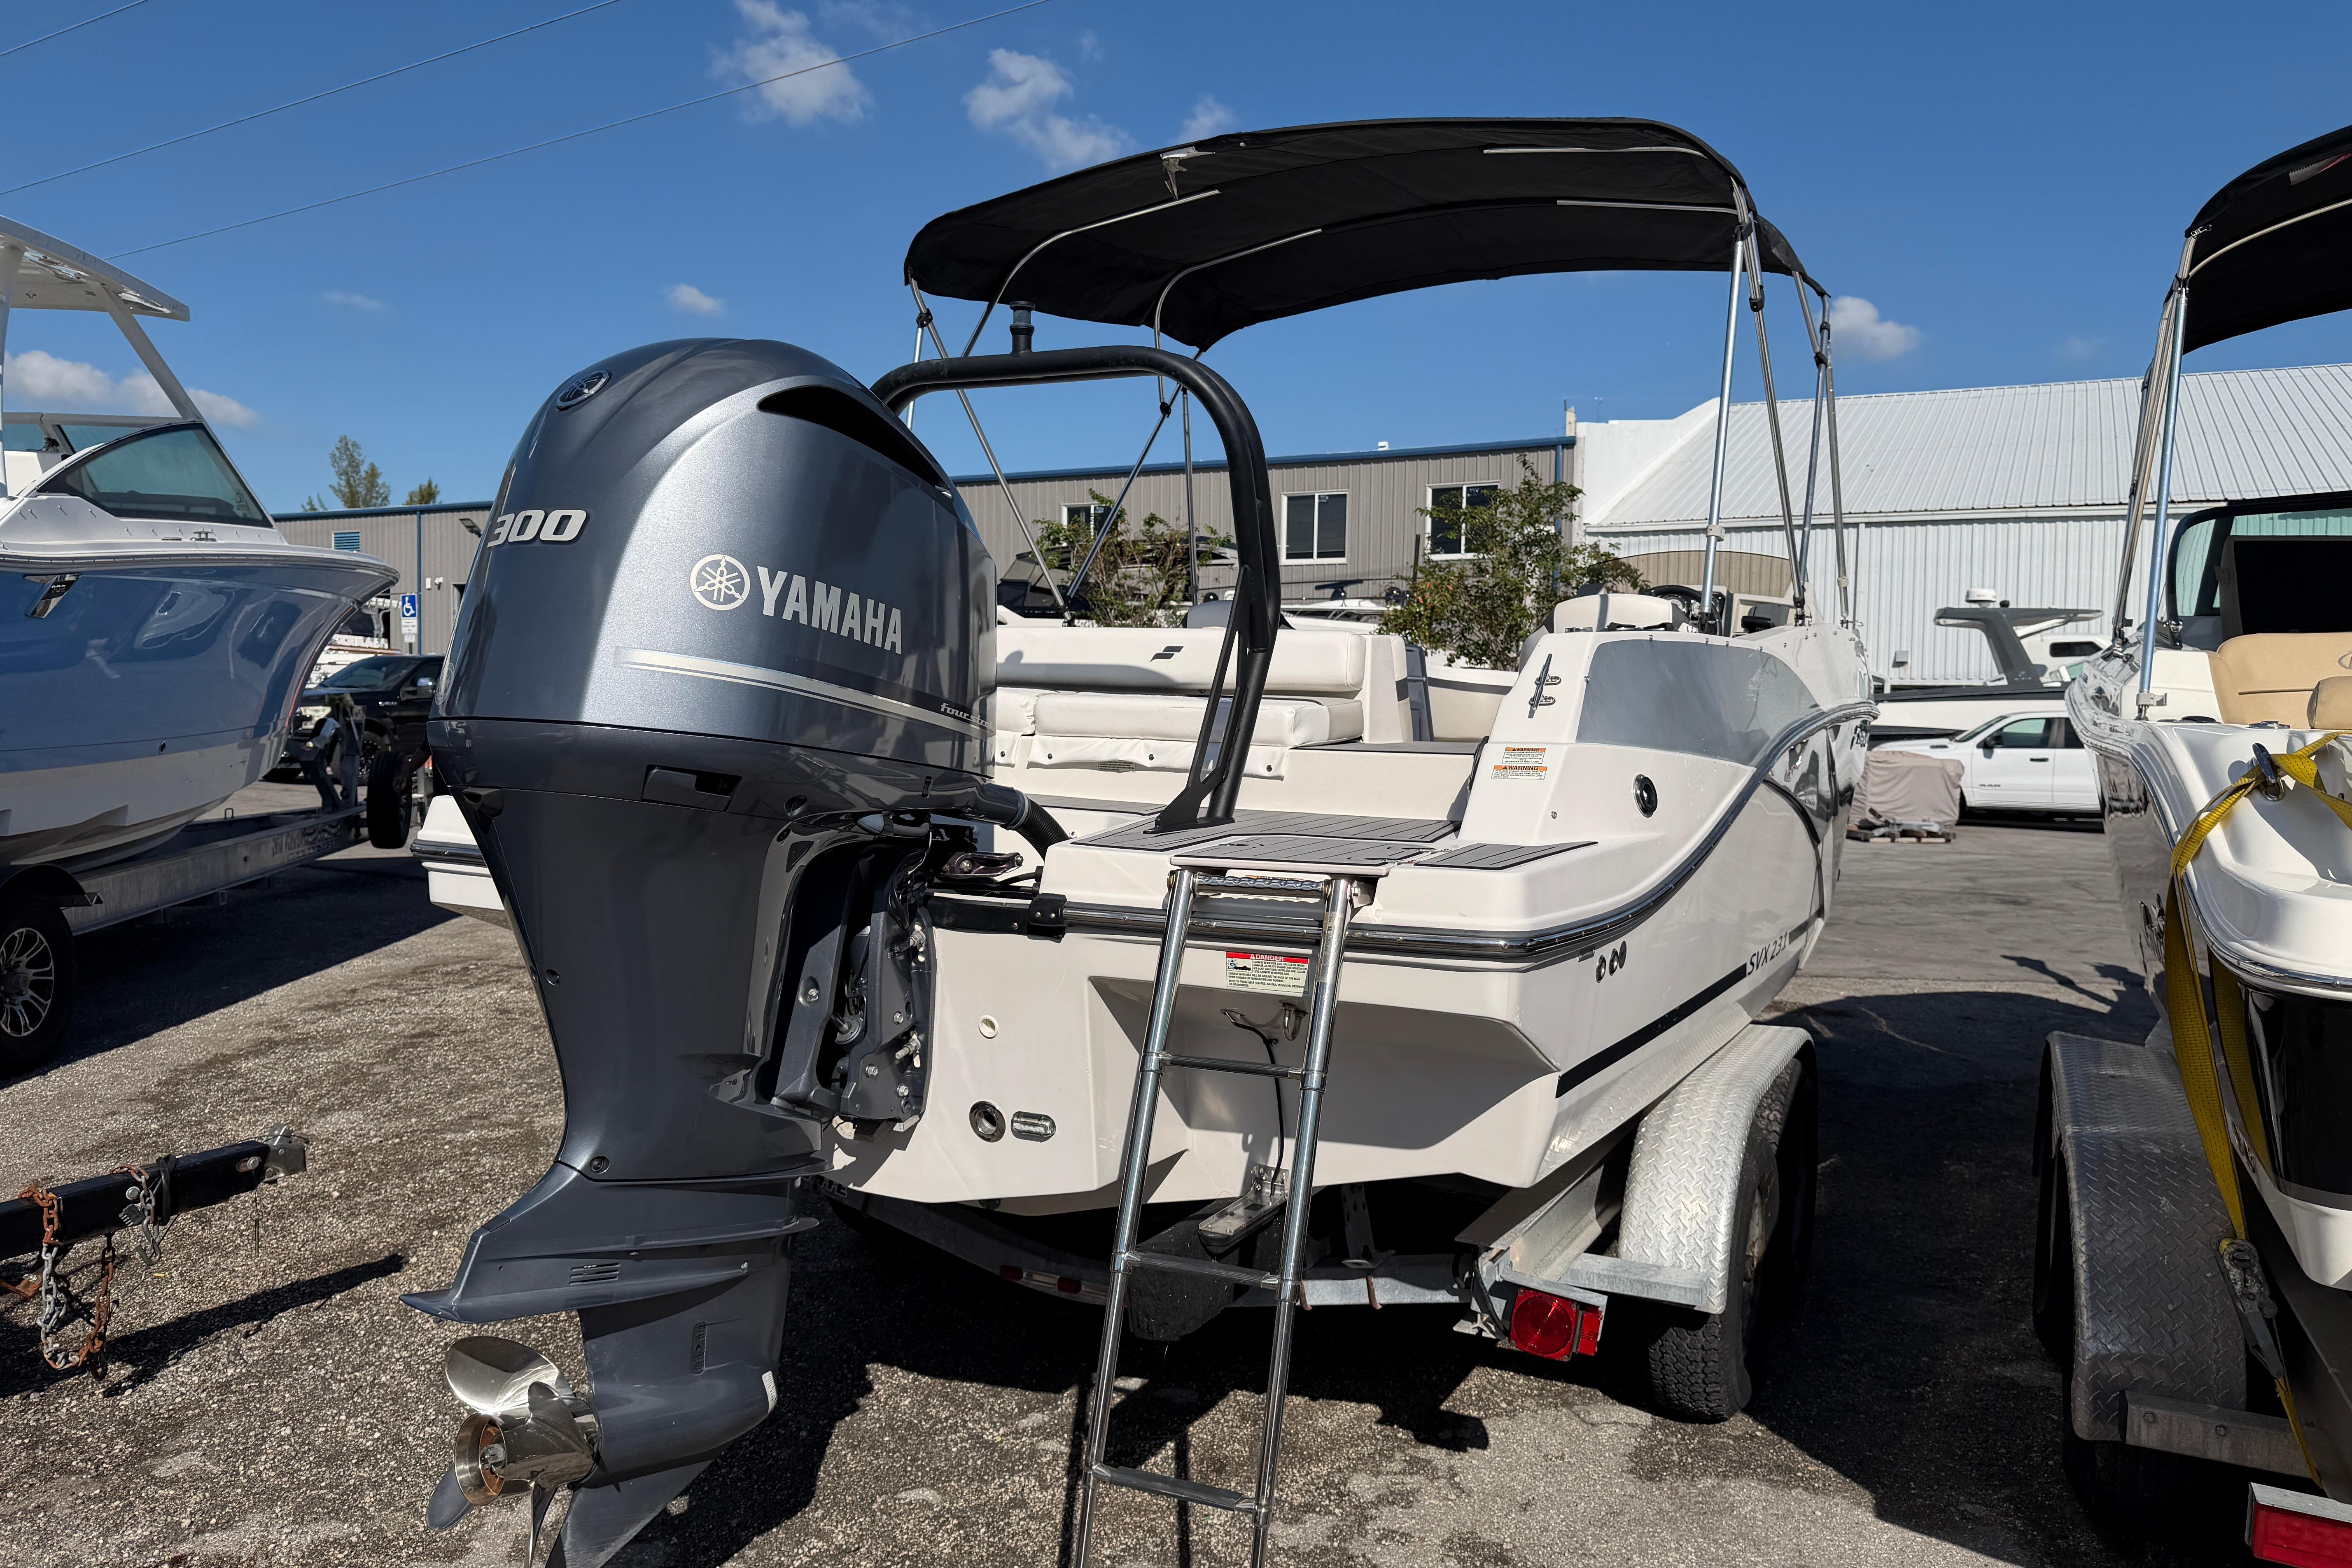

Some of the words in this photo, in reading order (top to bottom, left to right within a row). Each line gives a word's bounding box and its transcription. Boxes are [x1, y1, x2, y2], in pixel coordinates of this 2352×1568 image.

[487, 509, 587, 548] 300
[757, 566, 902, 655] YAMAHA
[1748, 943, 1770, 976] SVX
[1770, 931, 1787, 961] 231
